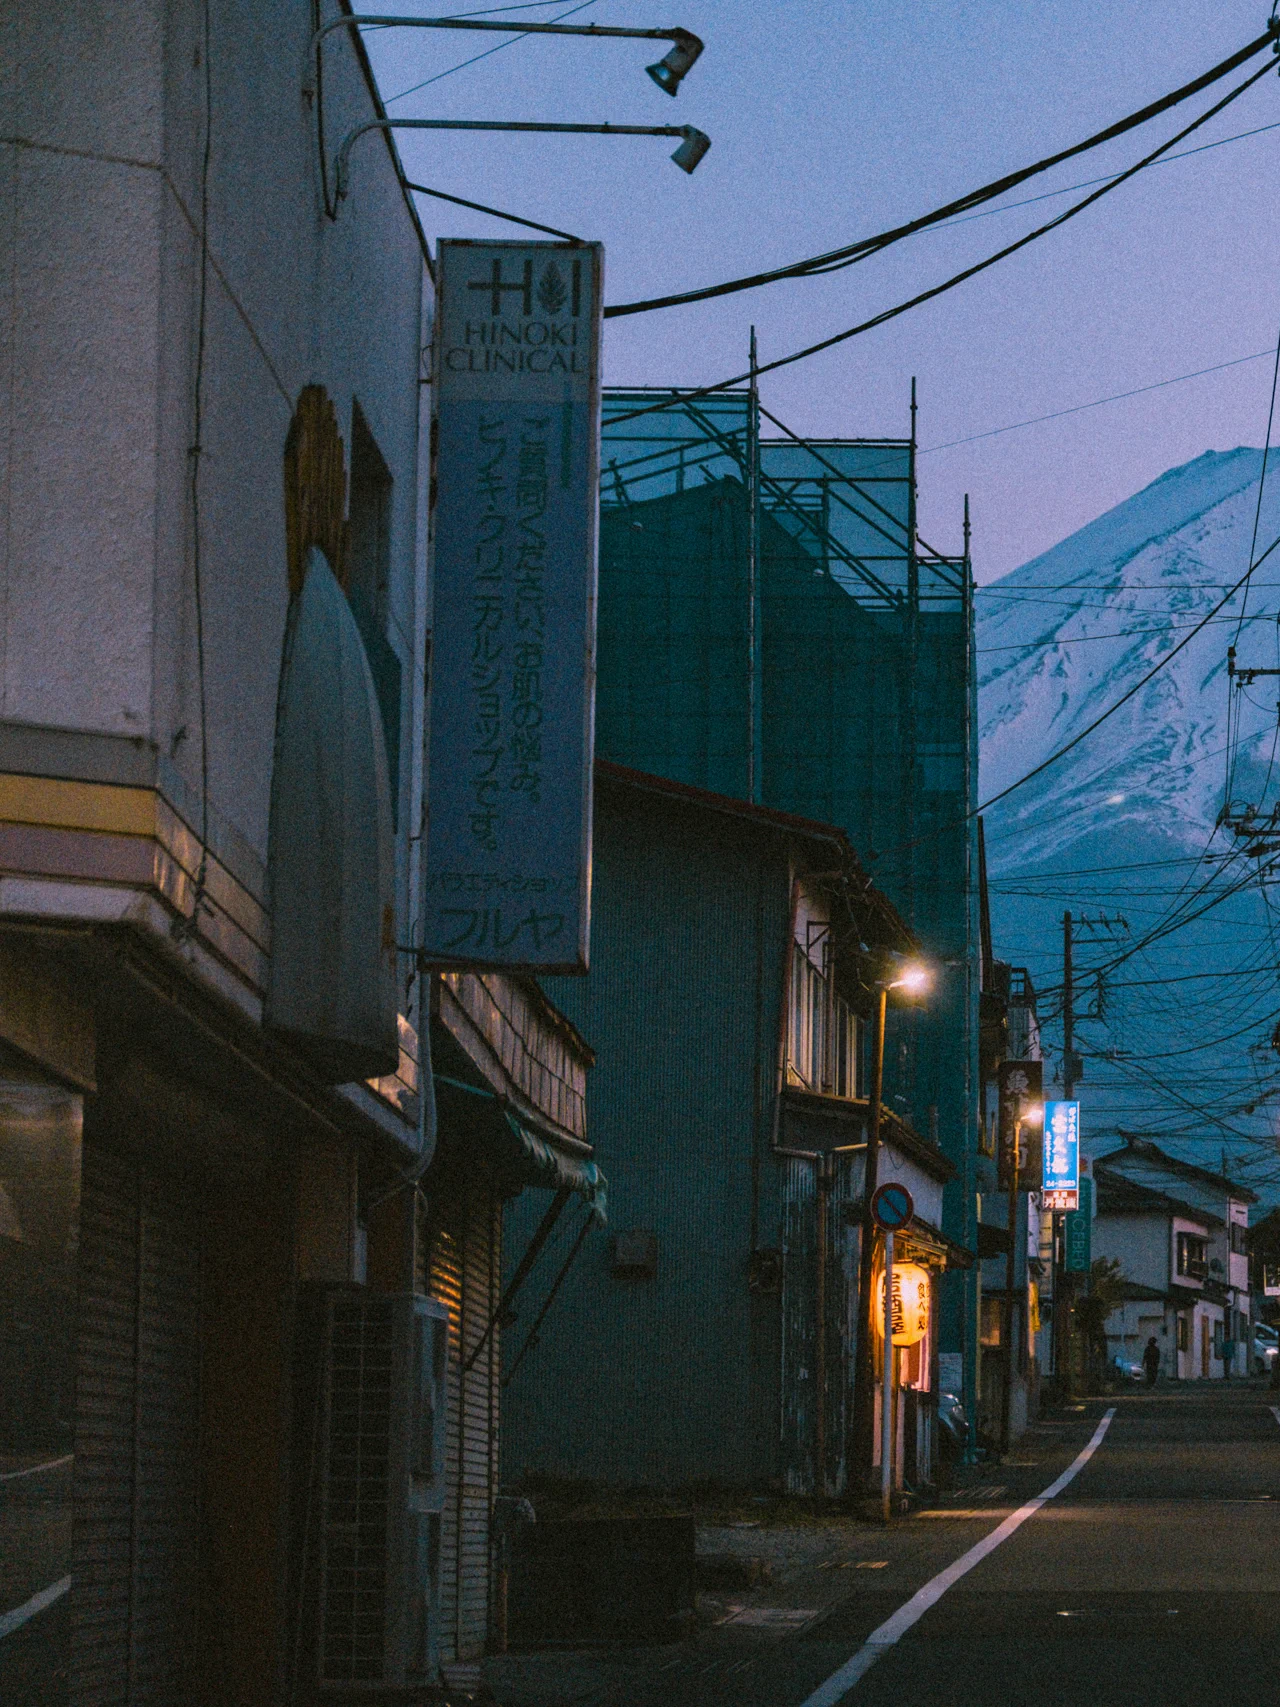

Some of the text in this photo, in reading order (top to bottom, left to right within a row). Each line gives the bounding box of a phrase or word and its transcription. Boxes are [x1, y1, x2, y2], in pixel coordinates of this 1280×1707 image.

[464, 321, 578, 346] HINOKI
[446, 347, 585, 374] CLINICAL
[439, 907, 565, 951] フルヤ
